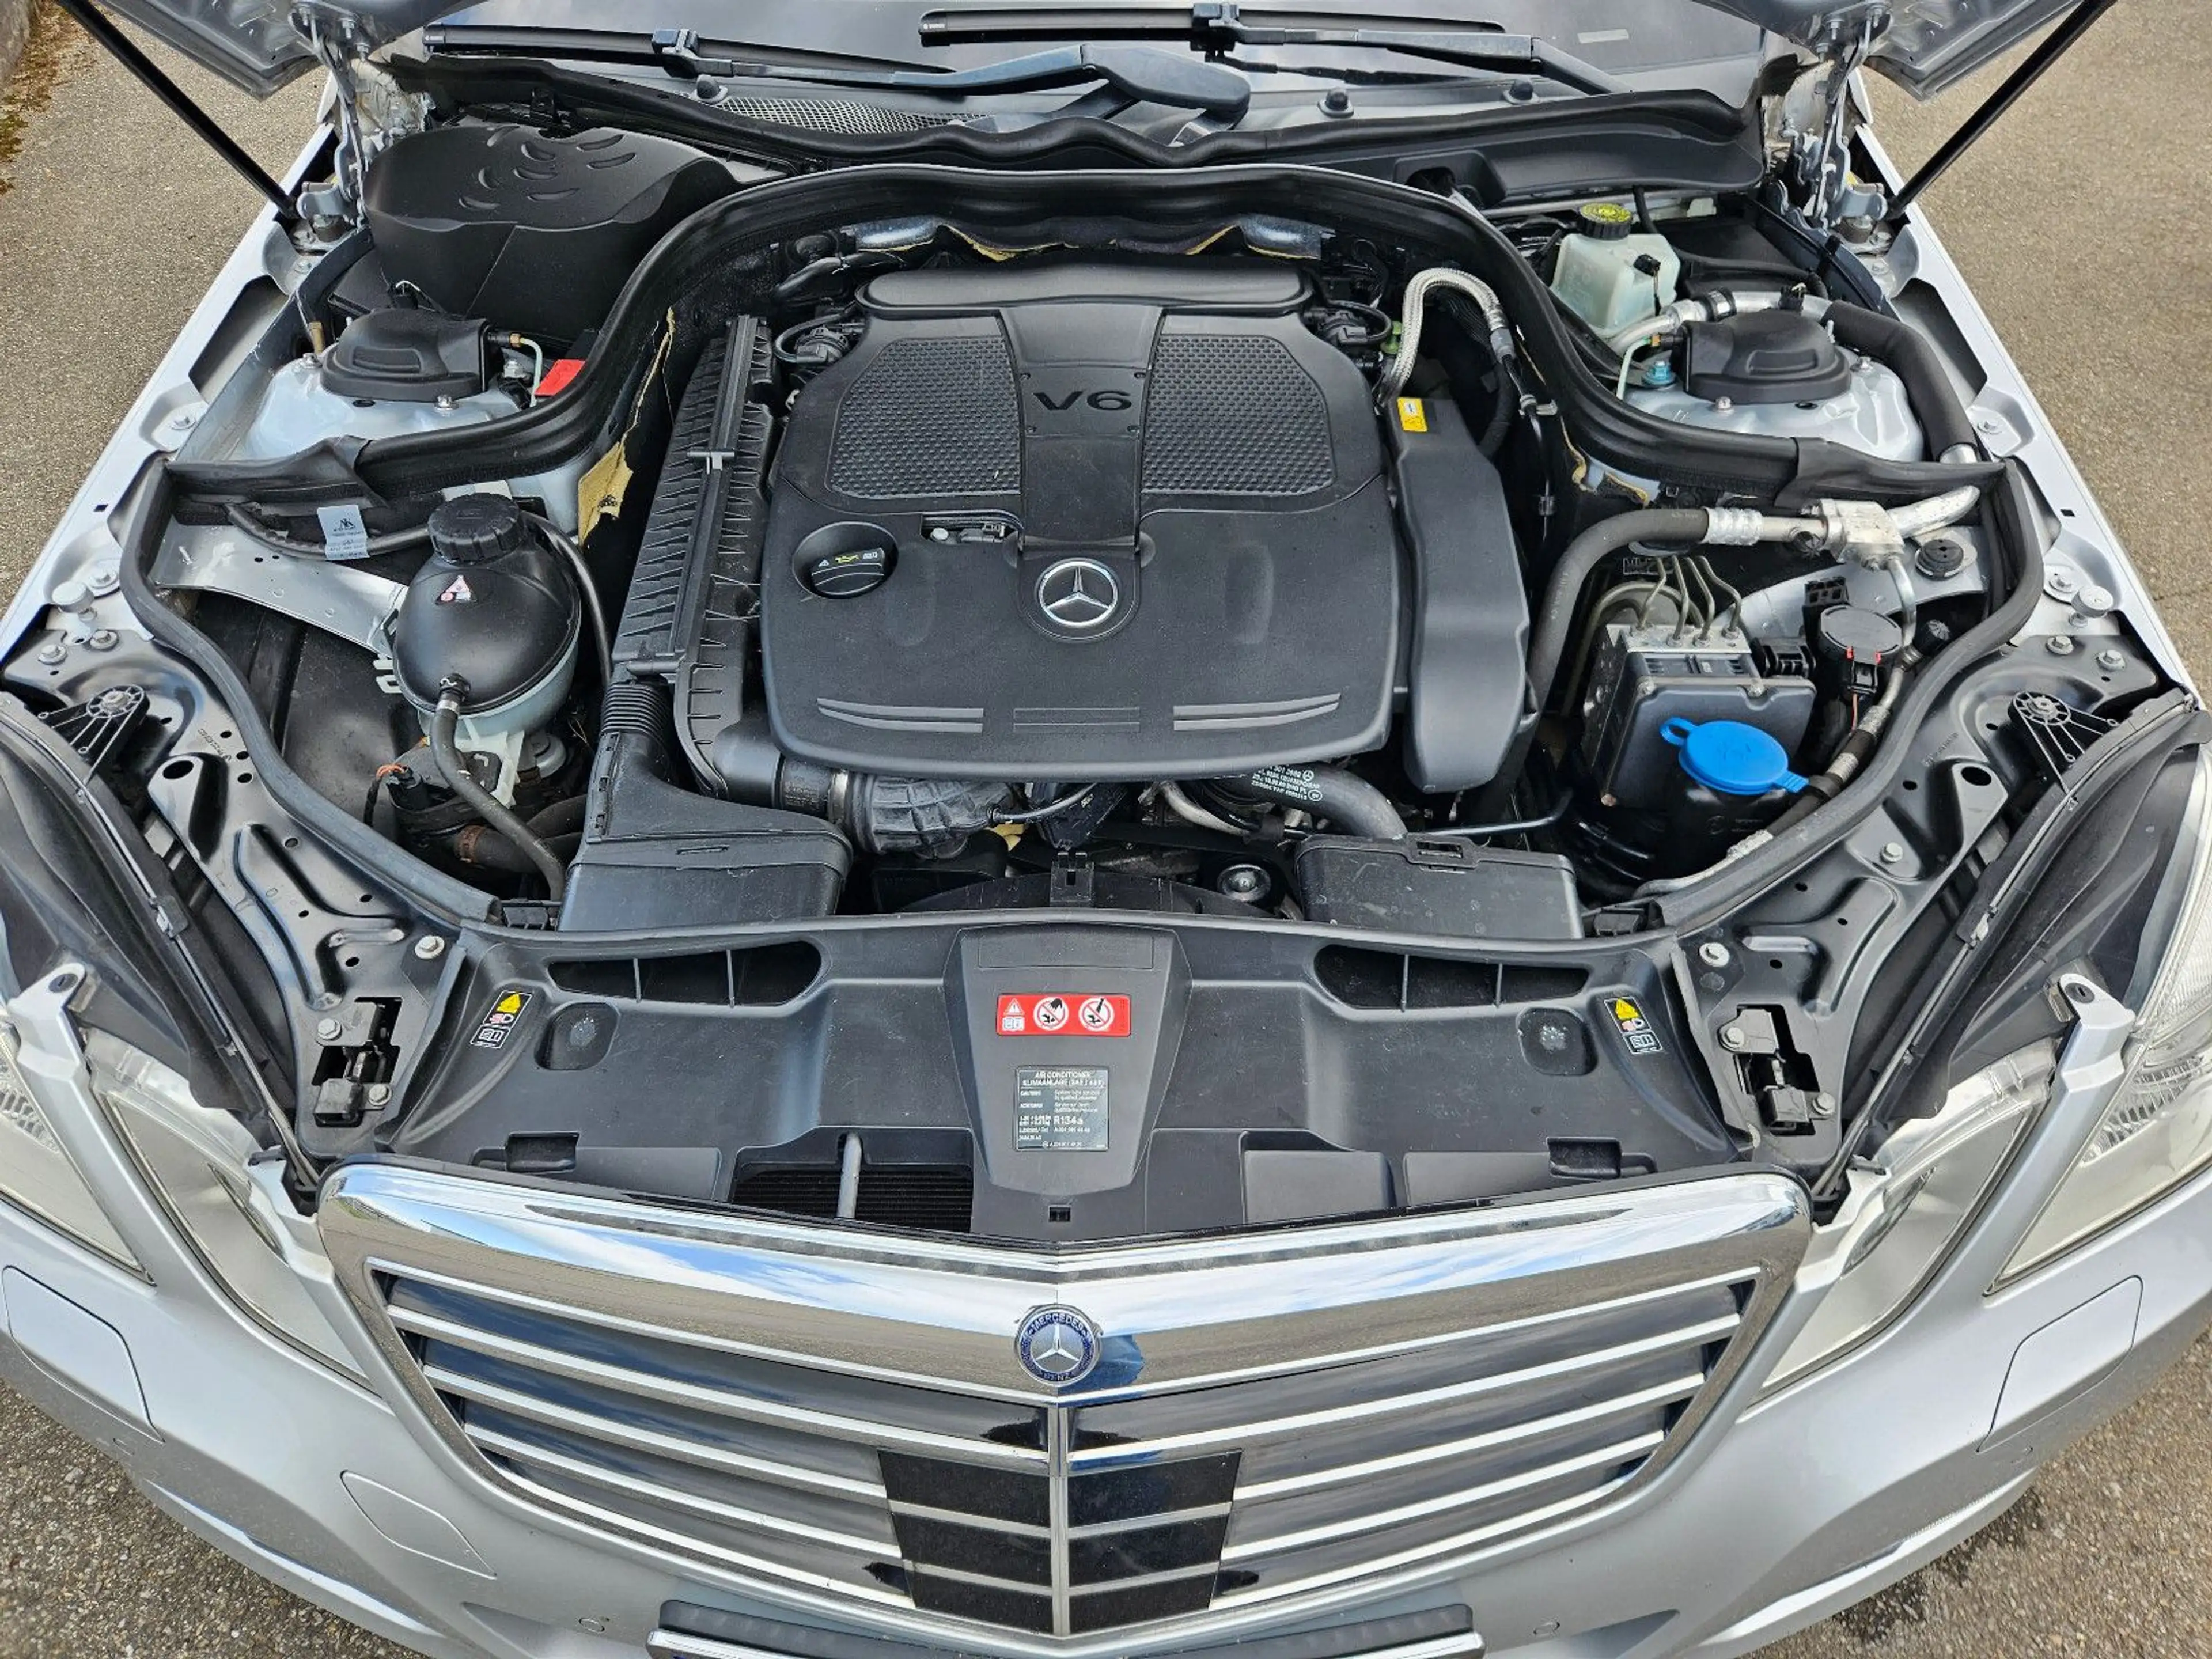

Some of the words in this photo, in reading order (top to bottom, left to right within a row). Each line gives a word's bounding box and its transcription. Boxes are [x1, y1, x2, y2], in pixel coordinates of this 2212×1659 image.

[1033, 390, 1132, 411] V6
[1054, 1115, 1083, 1124] R134a
[1031, 1313, 1084, 1332] MERCEDES
